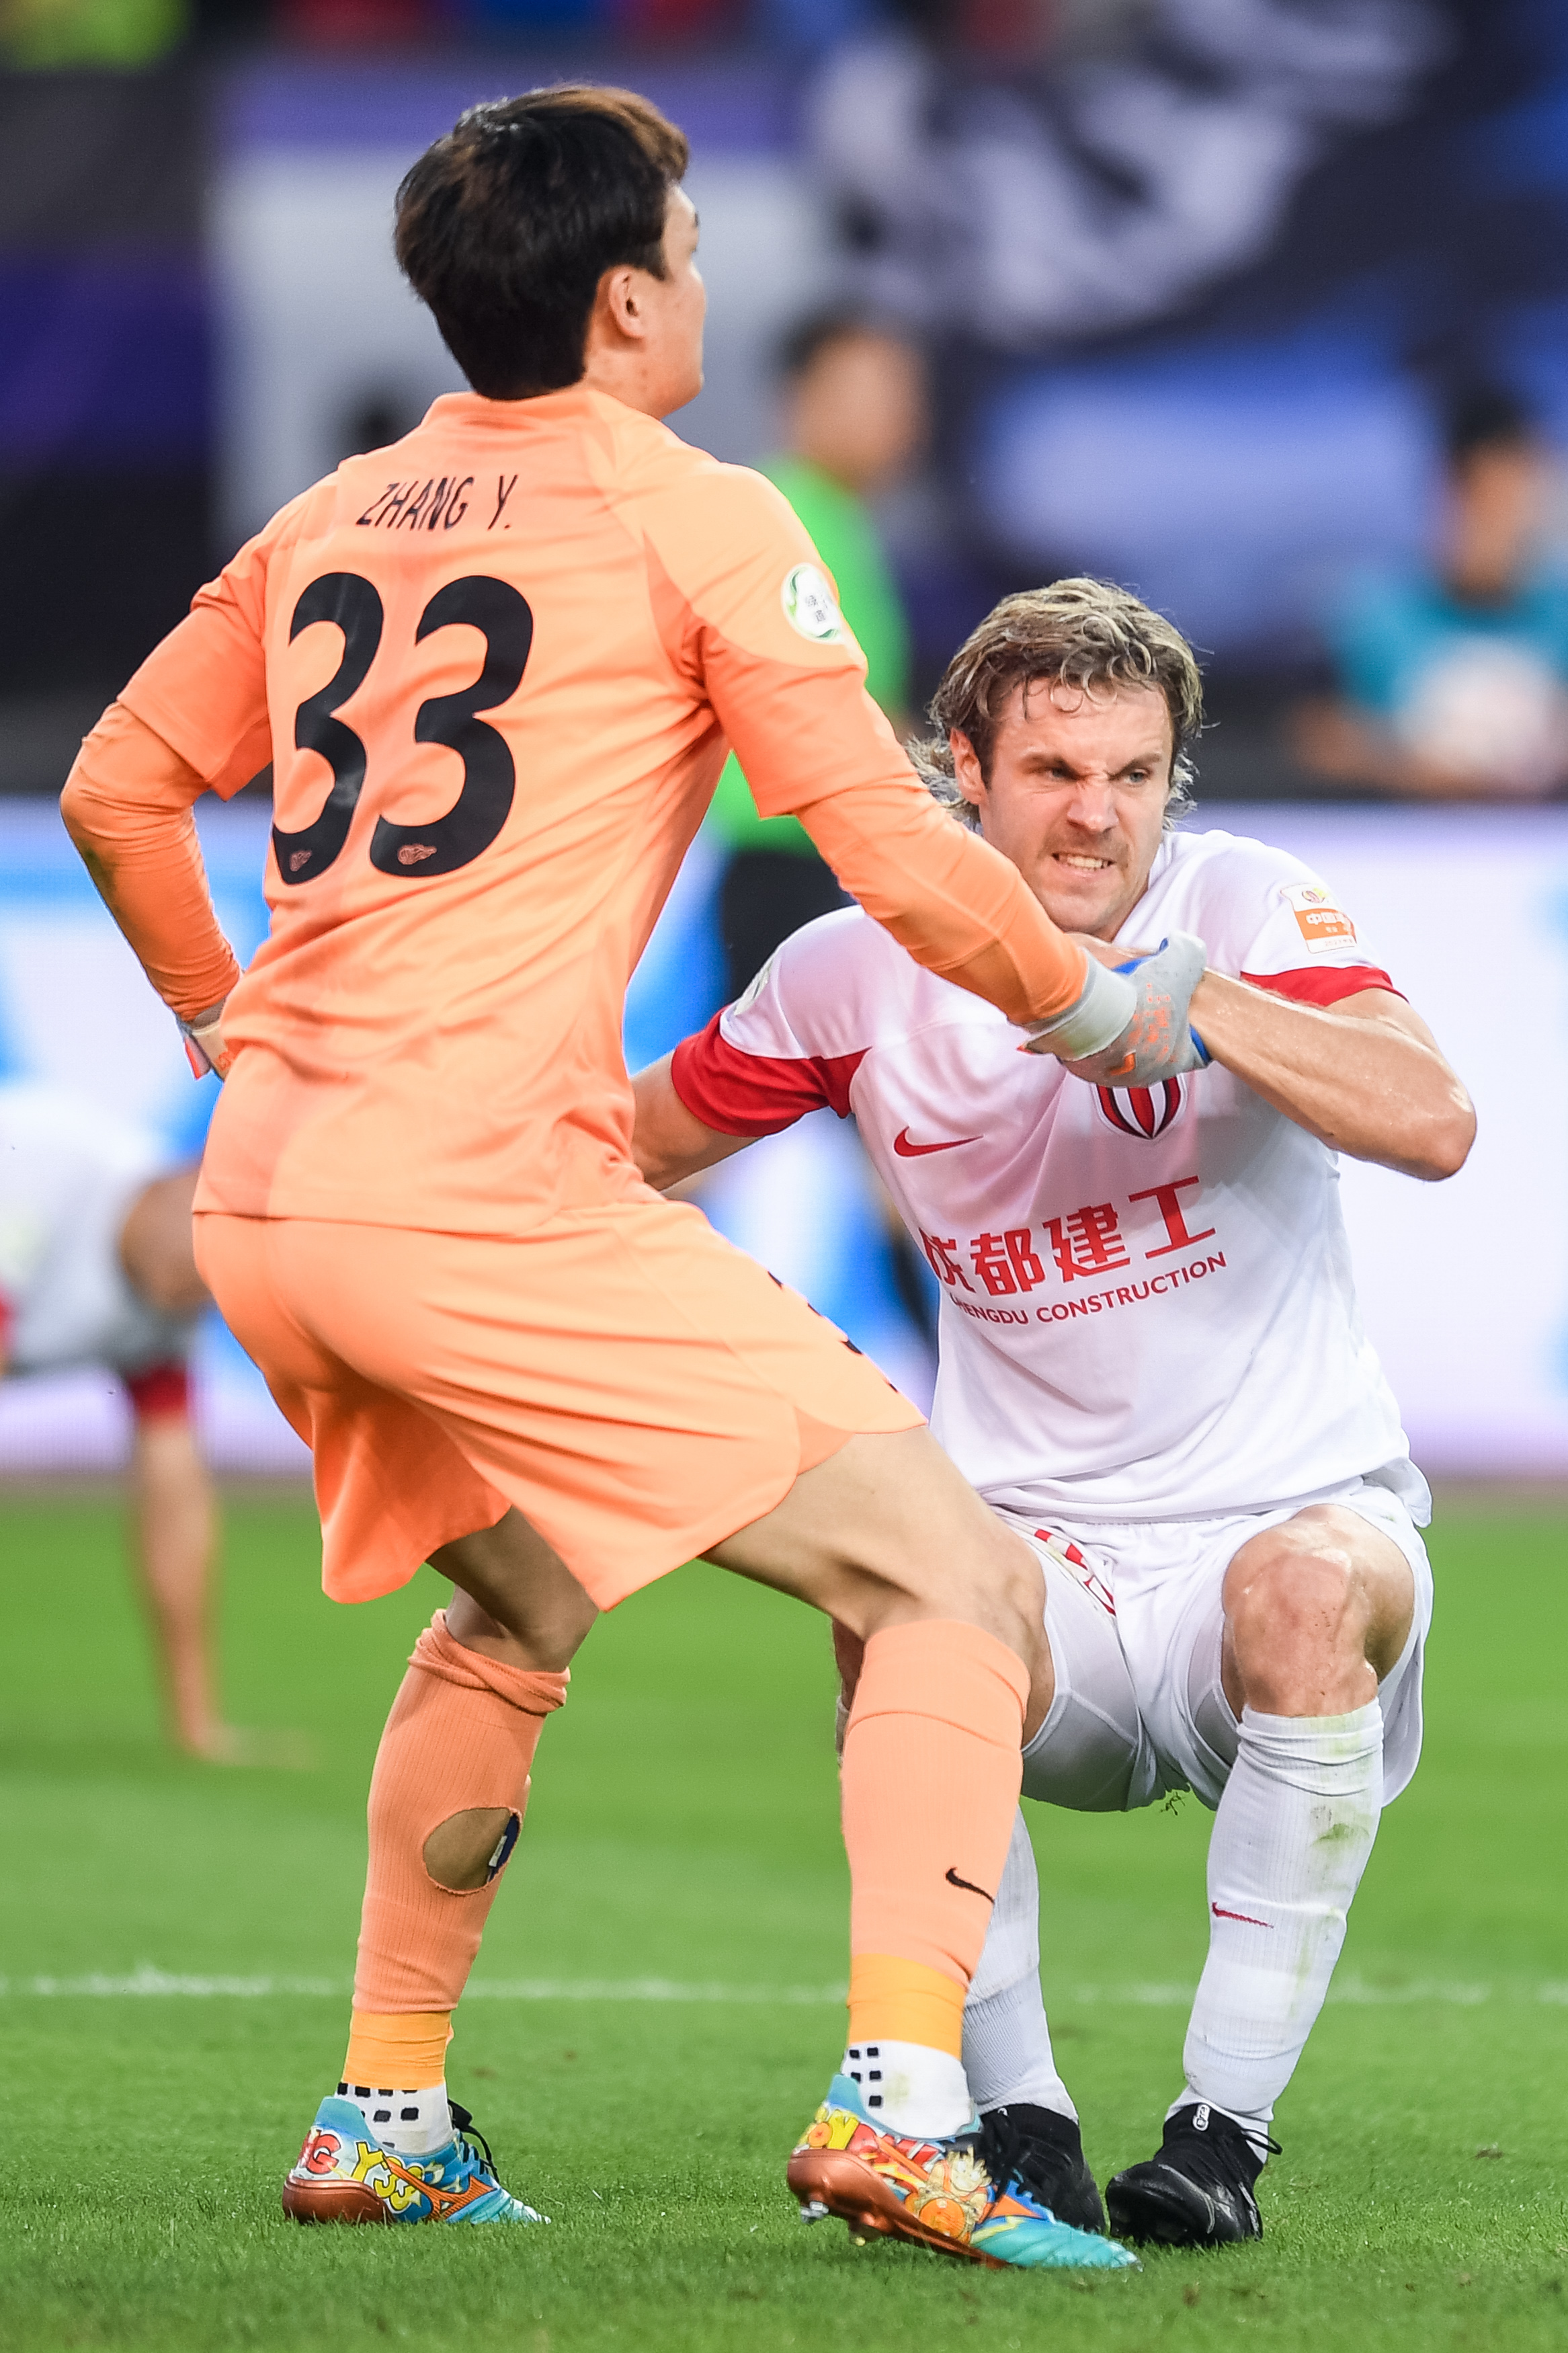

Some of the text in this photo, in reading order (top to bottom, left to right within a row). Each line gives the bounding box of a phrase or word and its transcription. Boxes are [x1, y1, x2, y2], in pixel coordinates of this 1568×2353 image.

[356, 475, 518, 530] ZHANG Y.
[272, 572, 534, 886] 33
[919, 1174, 1216, 1296] 成都建工
[1036, 1250, 1227, 1323] CONSTRUCTION
